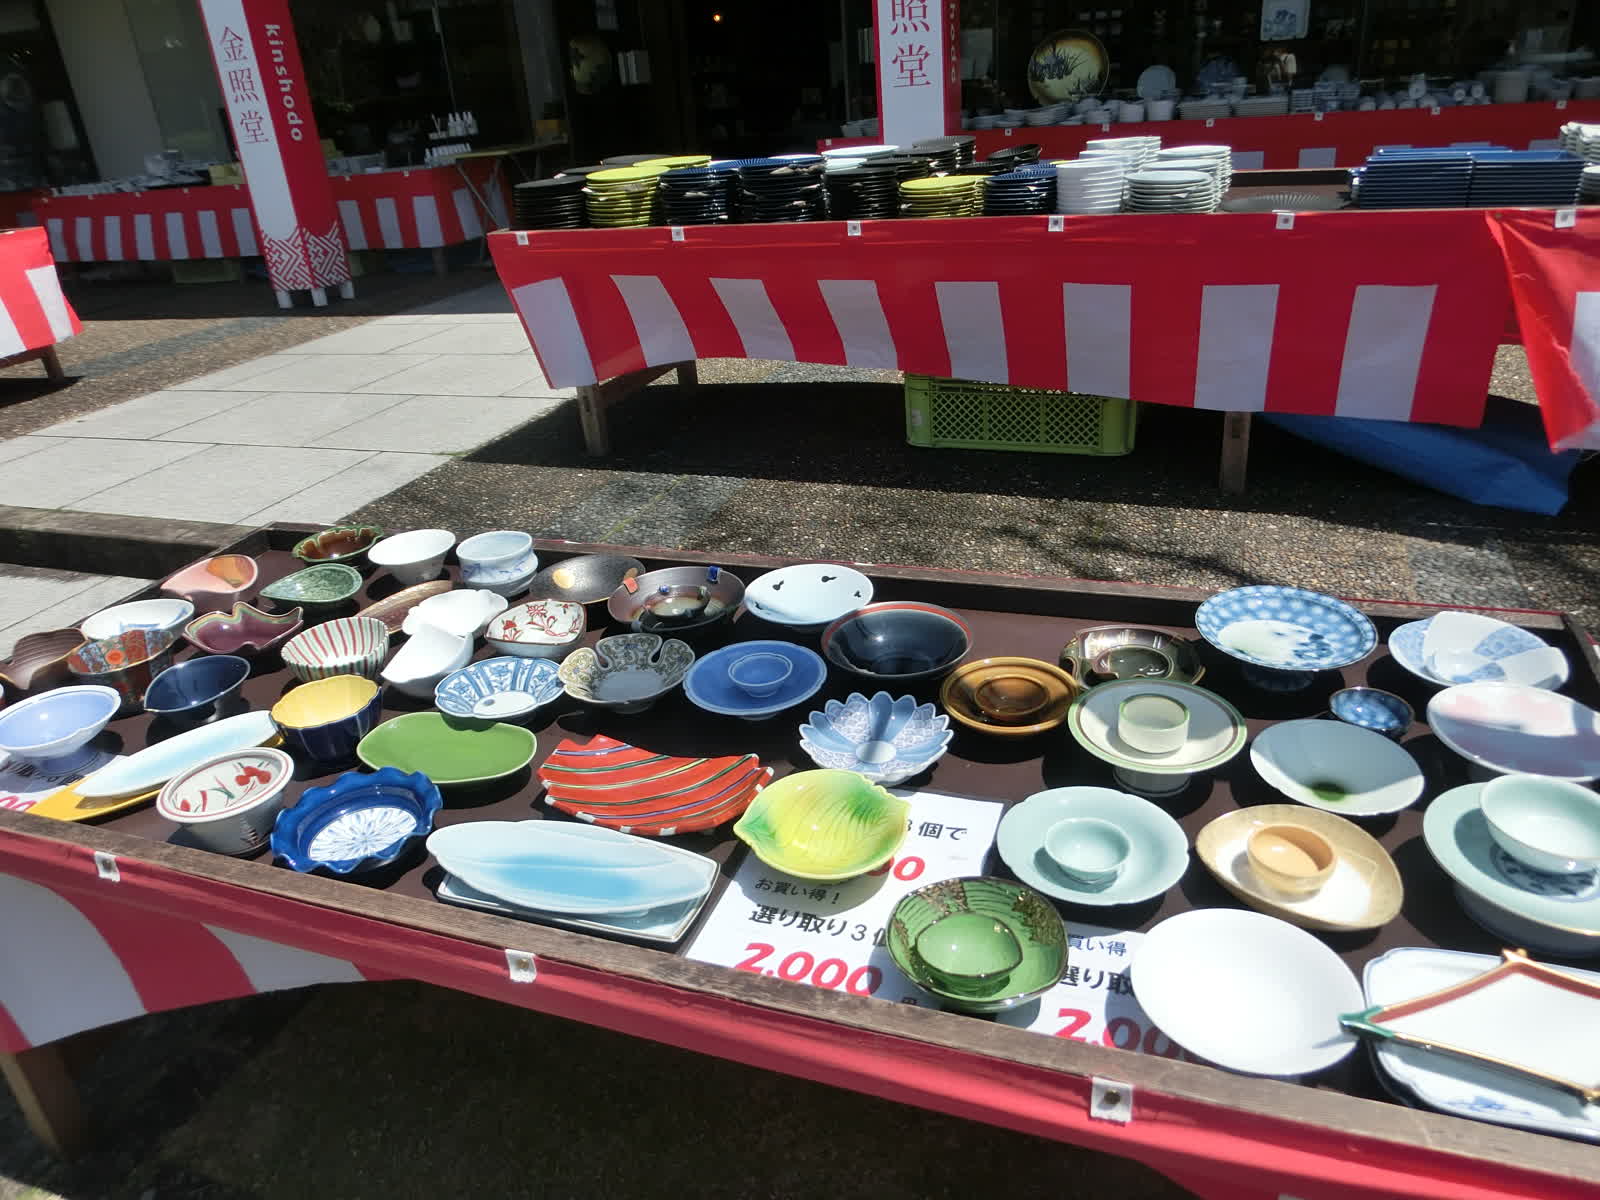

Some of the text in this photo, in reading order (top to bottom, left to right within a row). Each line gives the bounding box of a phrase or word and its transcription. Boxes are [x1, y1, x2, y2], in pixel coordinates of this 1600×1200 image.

[219, 25, 270, 144] 金照堂
[264, 23, 304, 142] kinshodo
